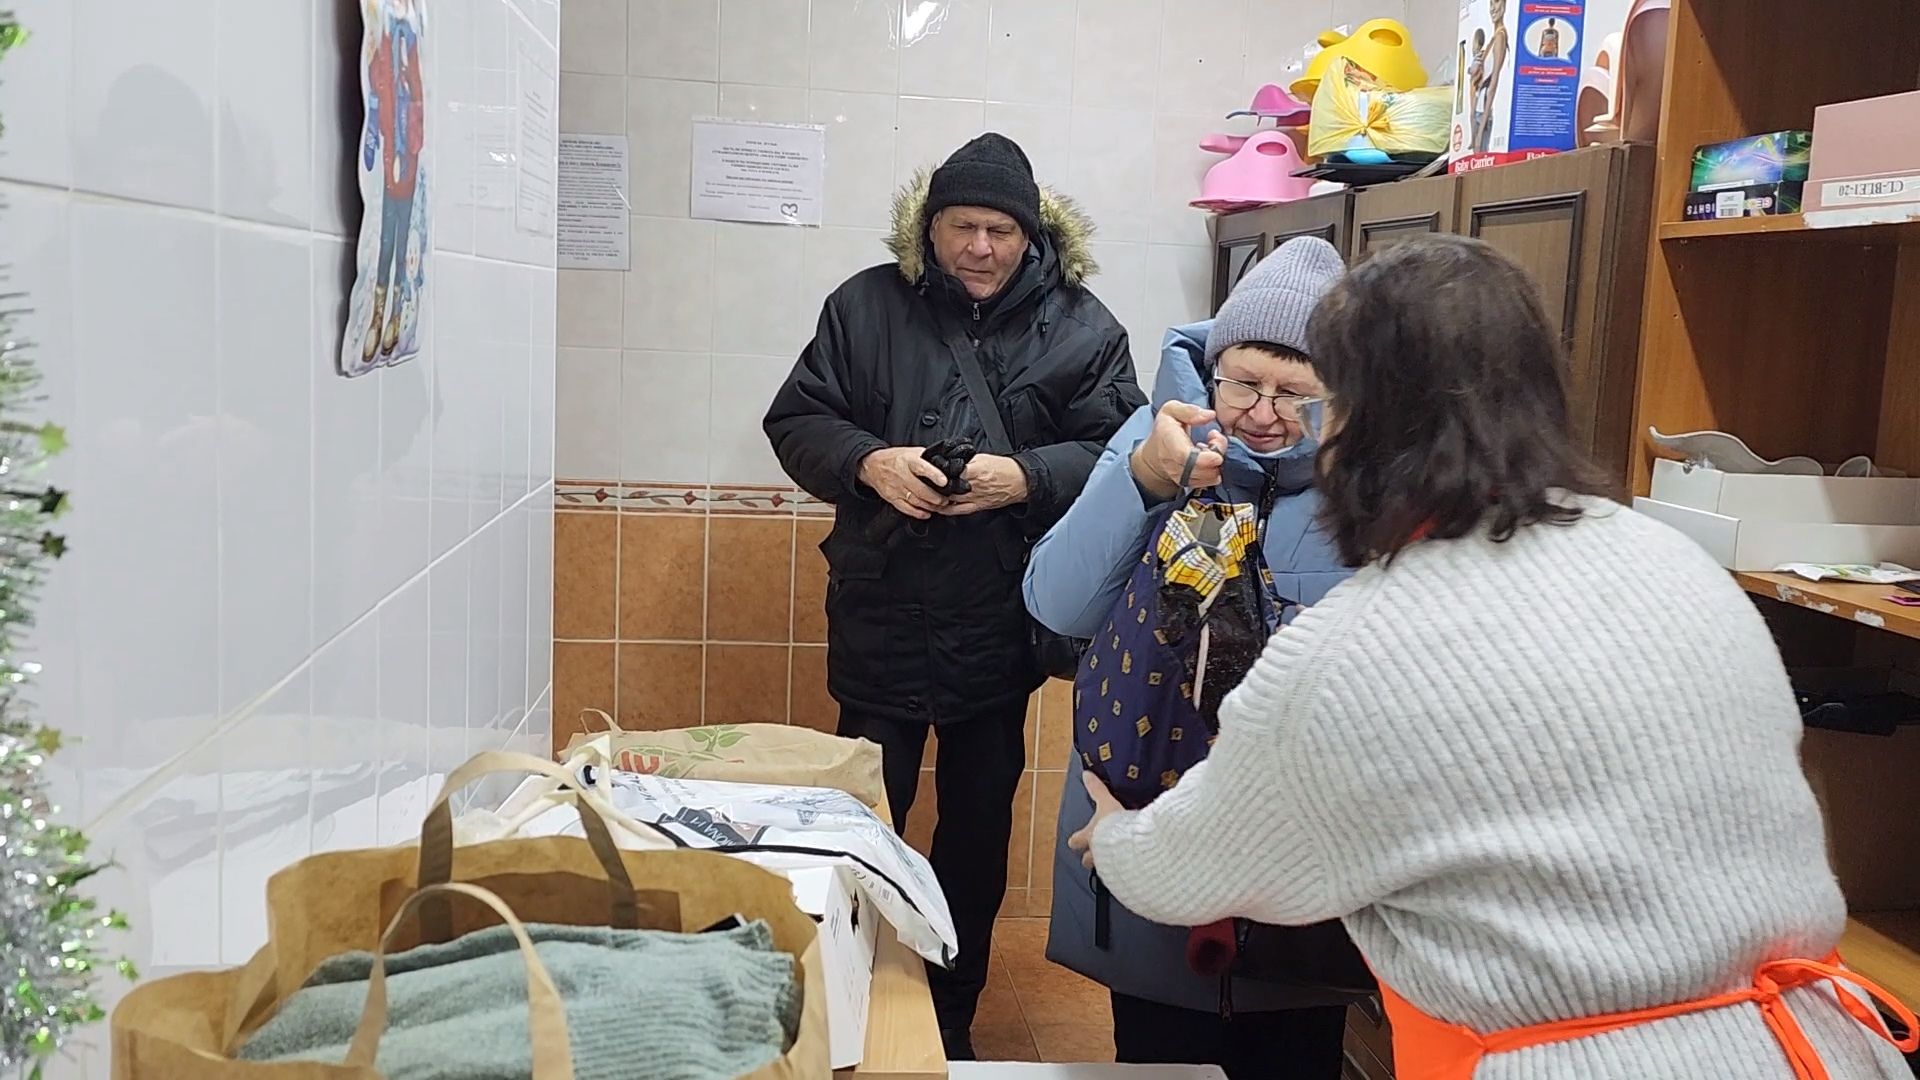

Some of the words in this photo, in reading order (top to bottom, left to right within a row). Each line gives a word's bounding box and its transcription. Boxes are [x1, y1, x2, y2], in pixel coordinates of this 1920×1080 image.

[1455, 160, 1469, 173] Baby
[1470, 155, 1495, 169] Carrier
[1686, 203, 1716, 216] IGHTS
